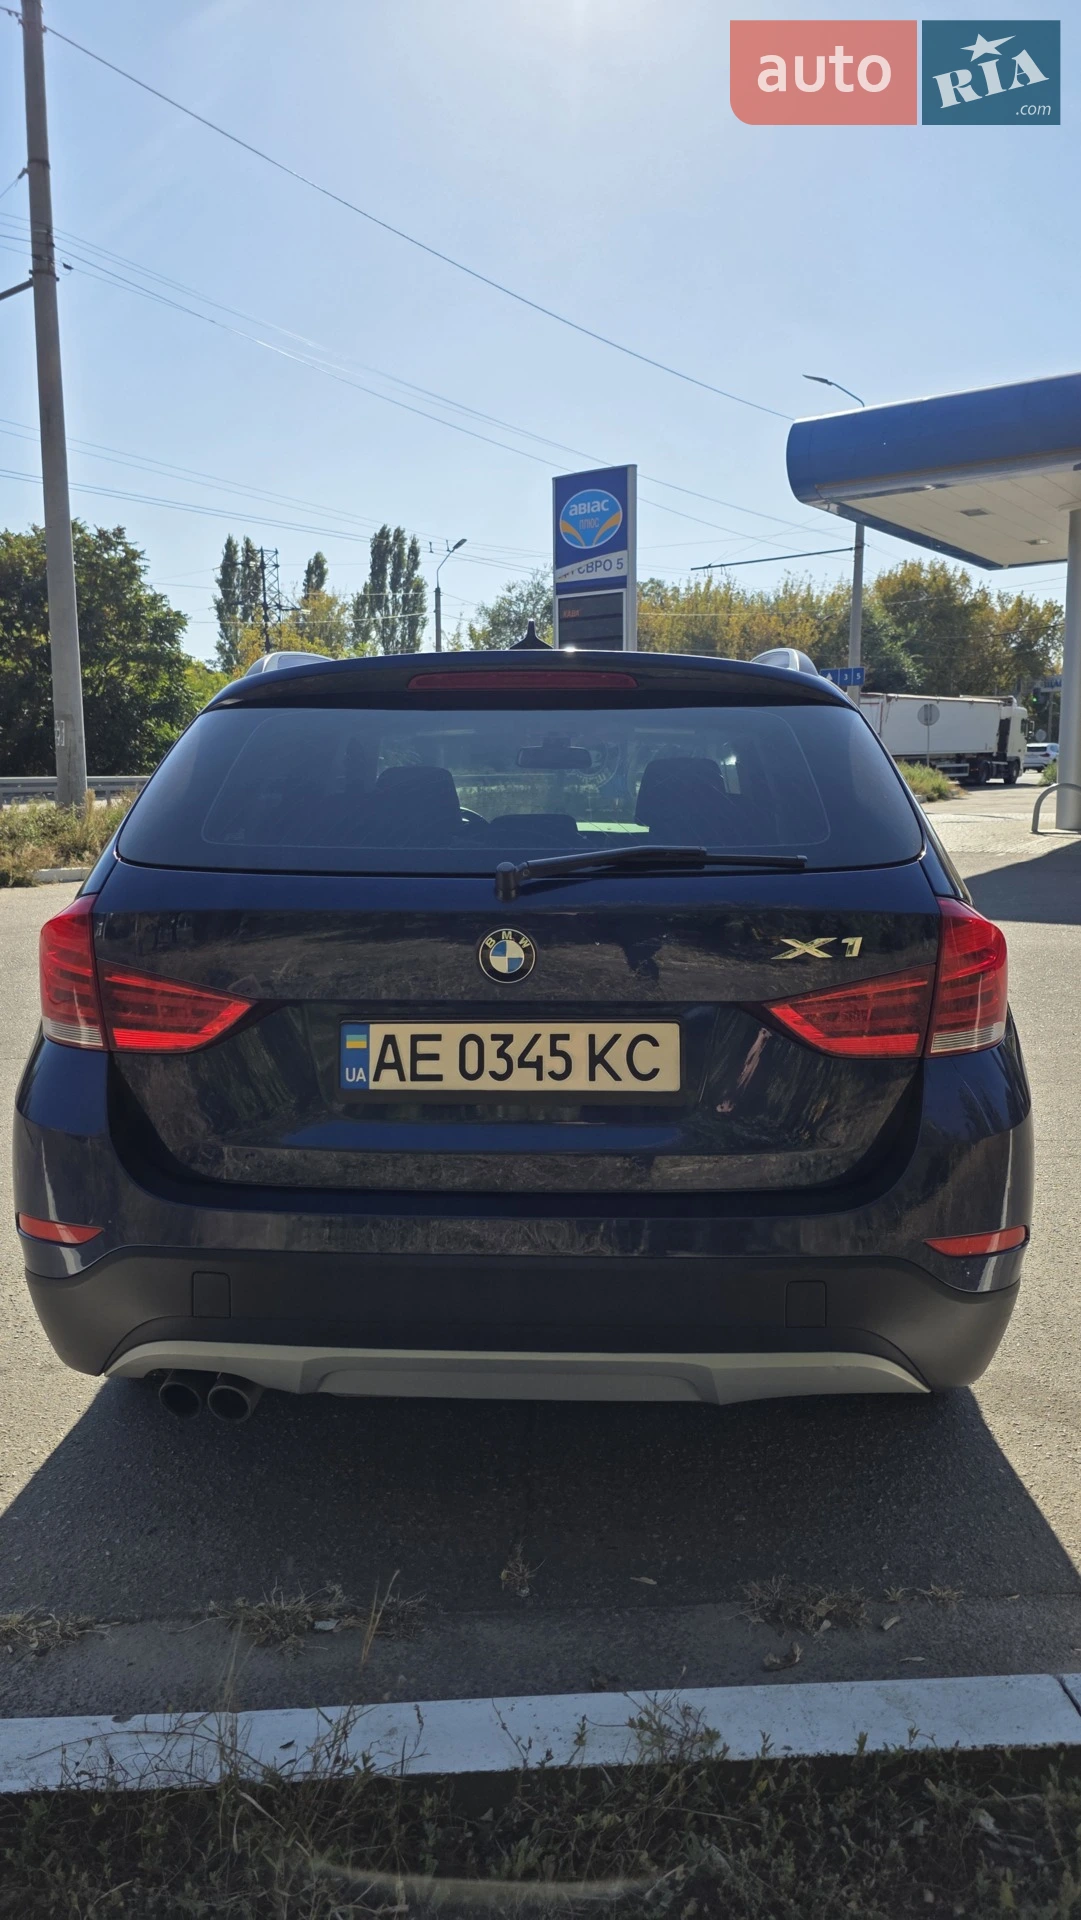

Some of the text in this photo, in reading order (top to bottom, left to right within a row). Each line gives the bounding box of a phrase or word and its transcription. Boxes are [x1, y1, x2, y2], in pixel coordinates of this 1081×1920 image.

[616, 557, 624, 570] 5
[856, 672, 861, 680] 5
[485, 930, 531, 949] BMW
[770, 936, 863, 960] X1
[372, 1033, 661, 1082] AE 0345 KC
[345, 1067, 367, 1082] UA
